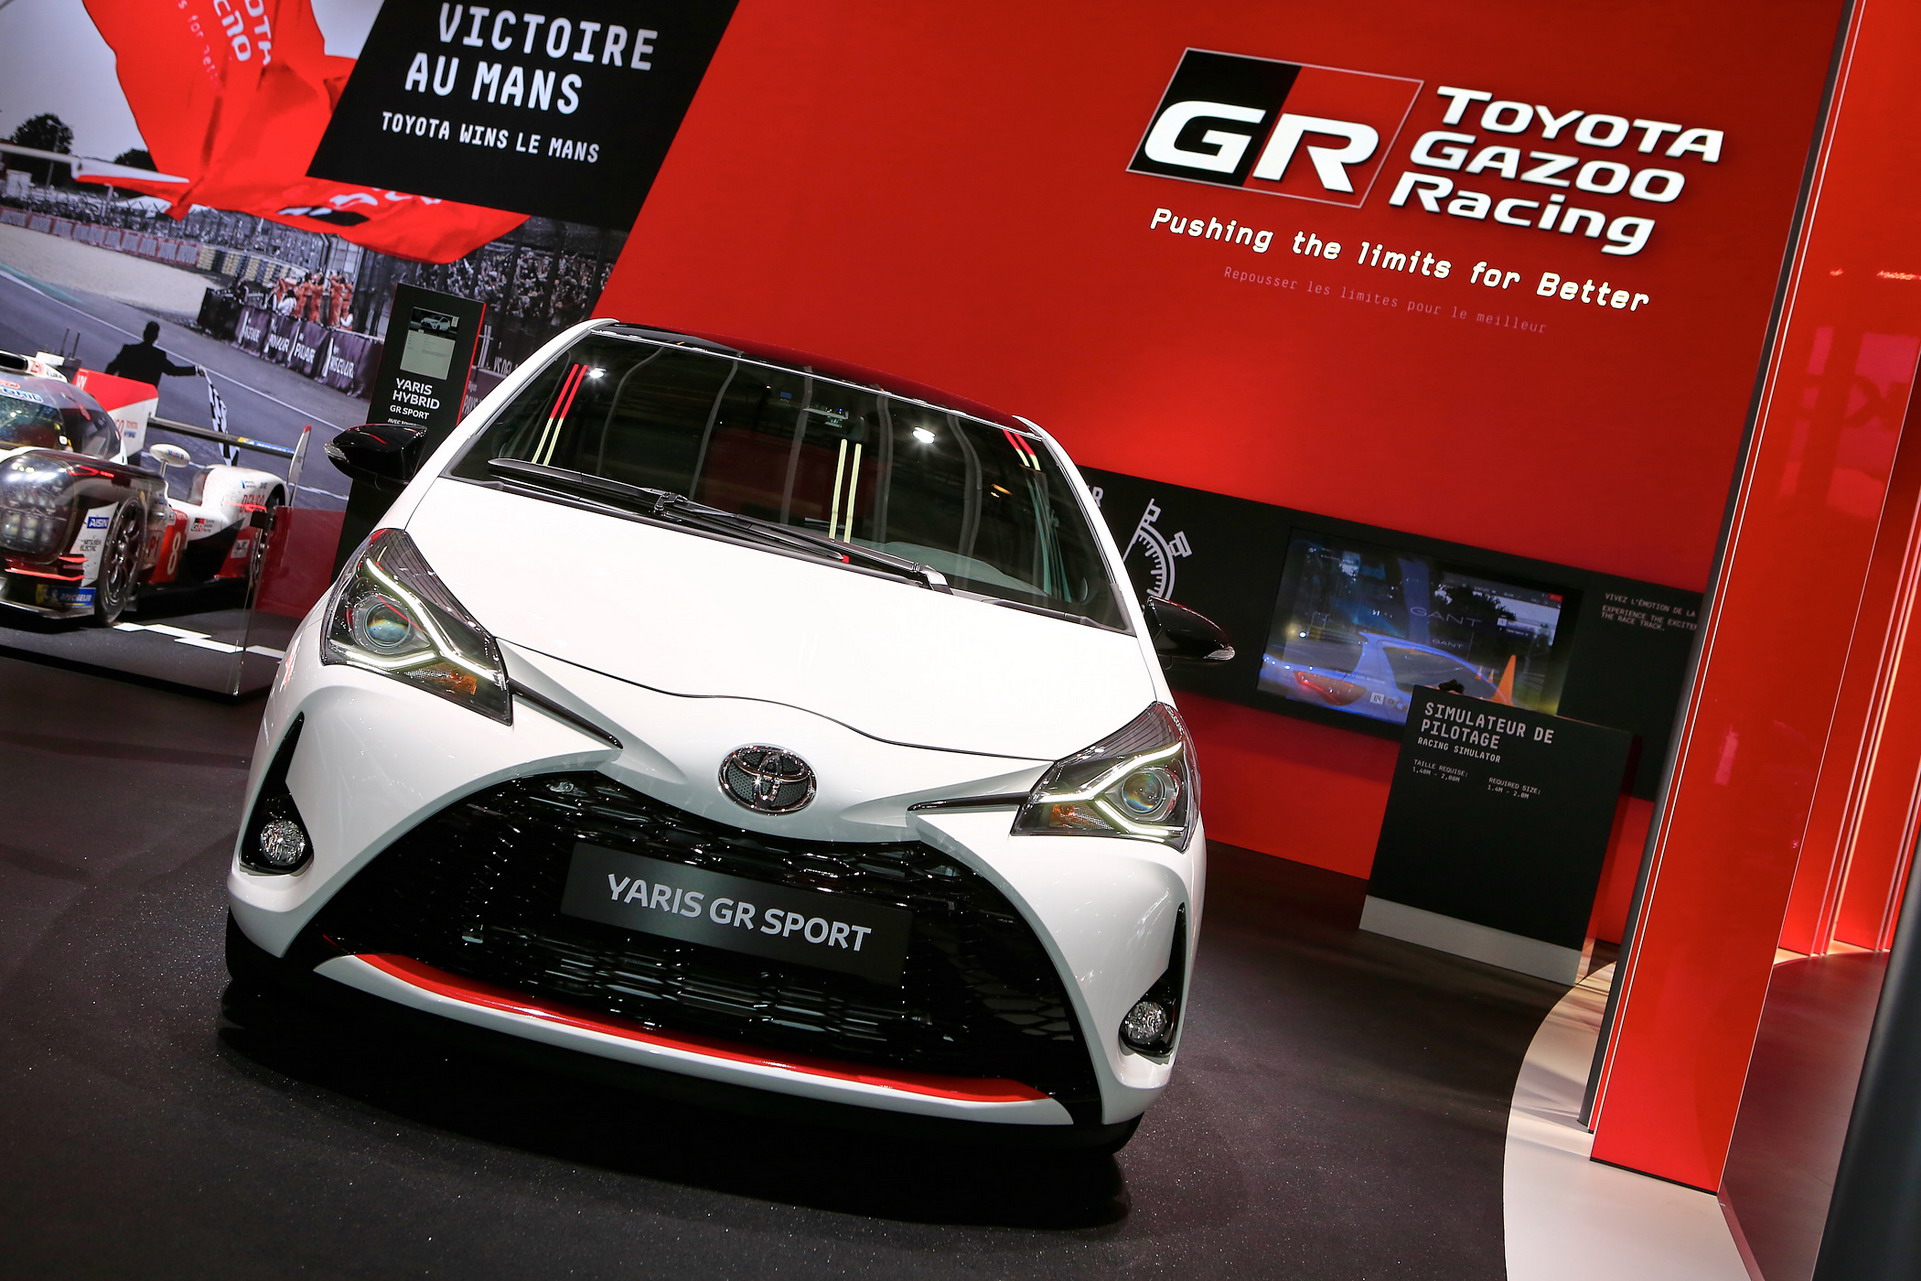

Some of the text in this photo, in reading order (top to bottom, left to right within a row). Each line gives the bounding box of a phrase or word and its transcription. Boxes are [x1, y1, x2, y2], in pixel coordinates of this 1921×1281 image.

[439, 2, 658, 71] VICTOIRE
[404, 52, 583, 115] AU MANS
[382, 111, 600, 163] TOYOTA WINS LE MANS
[1436, 85, 1725, 163] TOYOTA
[1144, 100, 1380, 193] GR
[1409, 130, 1686, 203] GAZOO
[1389, 170, 1656, 256] Racing
[1149, 207, 1650, 312] Pushing the limits for Better
[1224, 266, 1547, 334] Repousser les limites pour le meilleur
[392, 390, 440, 410] HYBRID
[396, 377, 433, 396] YARIS
[389, 404, 430, 420] GR SPORT
[88, 517, 110, 528] AISIN
[167, 531, 181, 575] 8
[1410, 606, 1482, 627] GANT
[1601, 612, 1614, 620] THE
[1618, 615, 1636, 625] RACE
[1602, 604, 1646, 619] EXPERIENCE
[1651, 615, 1664, 624] THE
[1605, 593, 1628, 603] VIVEZ
[1672, 607, 1683, 615] DE
[1432, 638, 1464, 649] GANT
[1421, 719, 1501, 750] PILOTAGE
[1424, 702, 1555, 744] SIMULATEUR DE
[1413, 759, 1436, 770] TAILLE
[1417, 736, 1501, 763] RACING SIMULATOR
[1488, 777, 1520, 790] REQUIRED
[607, 873, 872, 952] YARIS GR SPORT
